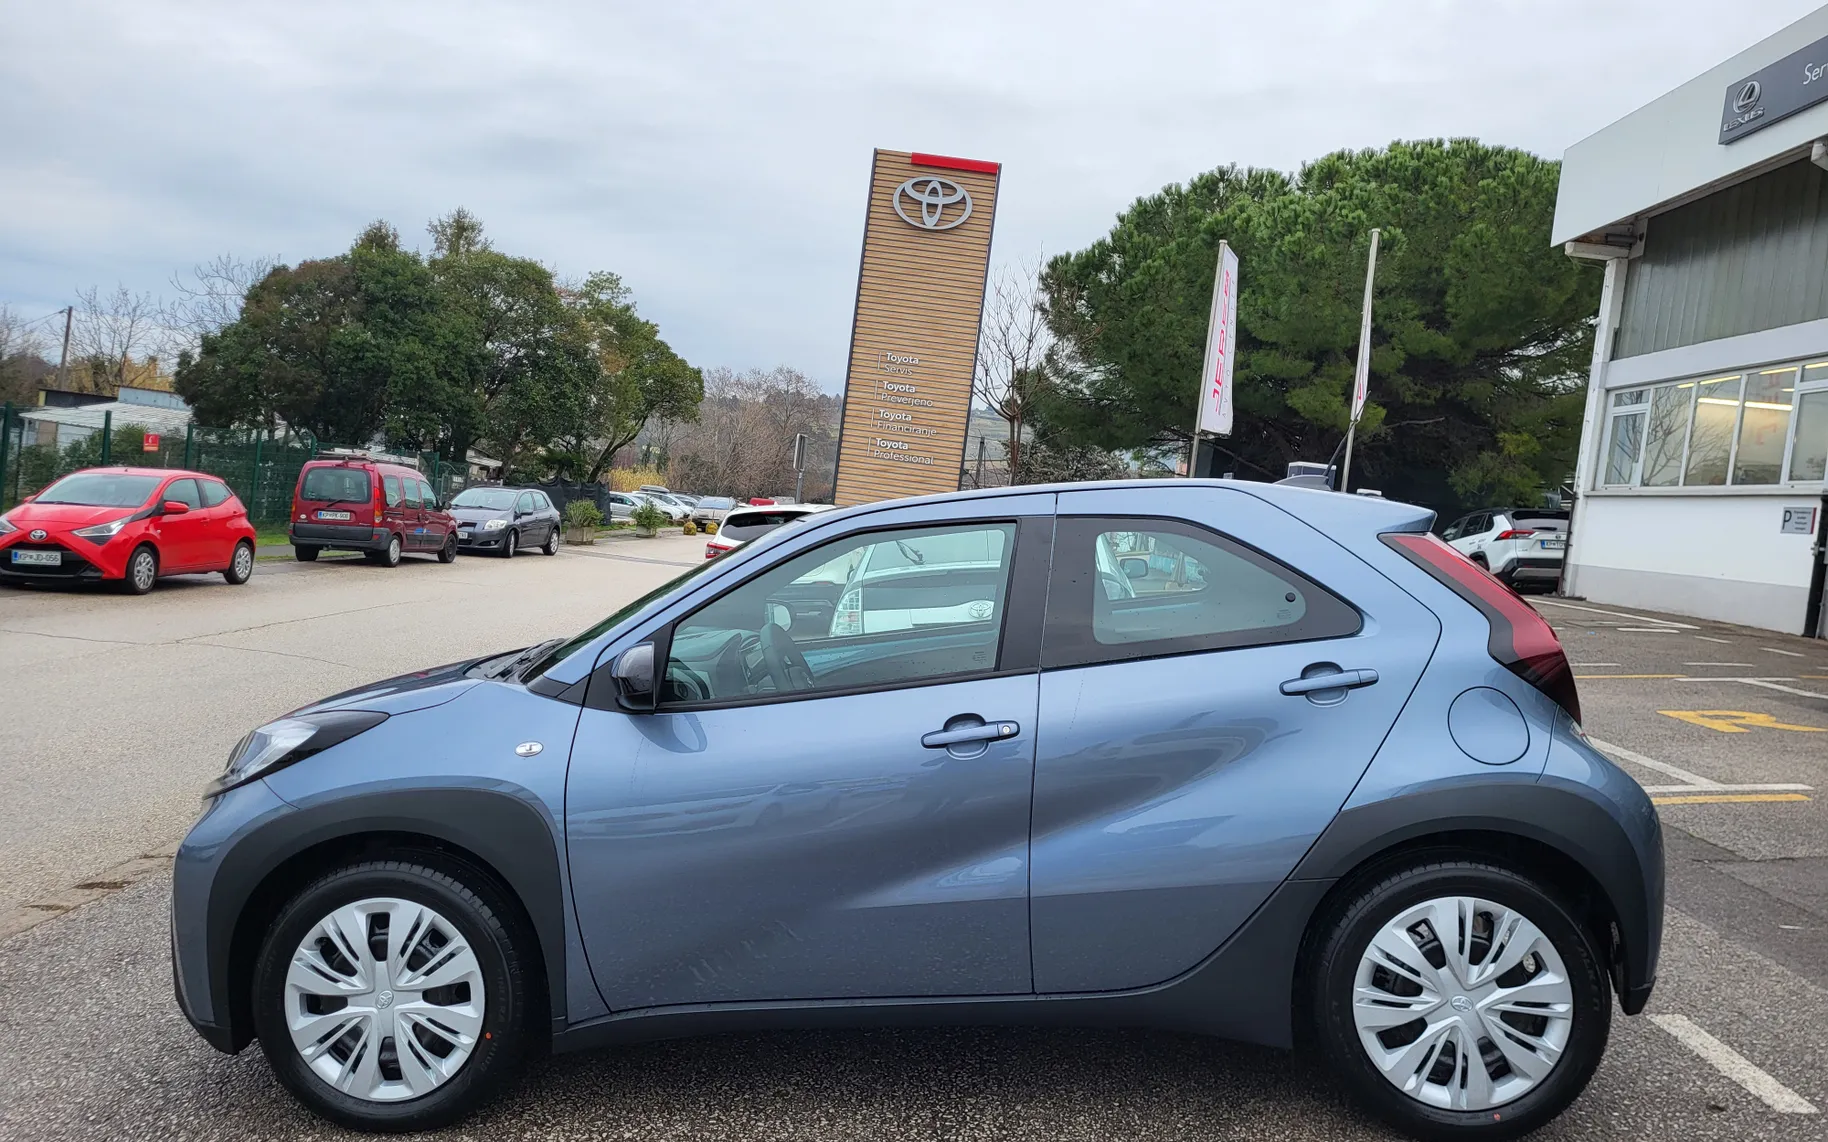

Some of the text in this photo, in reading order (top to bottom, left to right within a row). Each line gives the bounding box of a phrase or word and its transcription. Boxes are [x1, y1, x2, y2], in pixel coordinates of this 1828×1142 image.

[1803, 62, 1828, 85] Ser
[1723, 107, 1764, 131] LEXUS
[886, 352, 919, 364] Toyota
[884, 364, 913, 376] Servis
[882, 381, 916, 393] Toyota
[881, 393, 934, 407] Preverjeno
[879, 409, 912, 421] Toyota
[877, 421, 937, 437] Financiranje
[876, 438, 909, 450] Toyota
[874, 450, 934, 465] Professional
[1783, 510, 1792, 530] P
